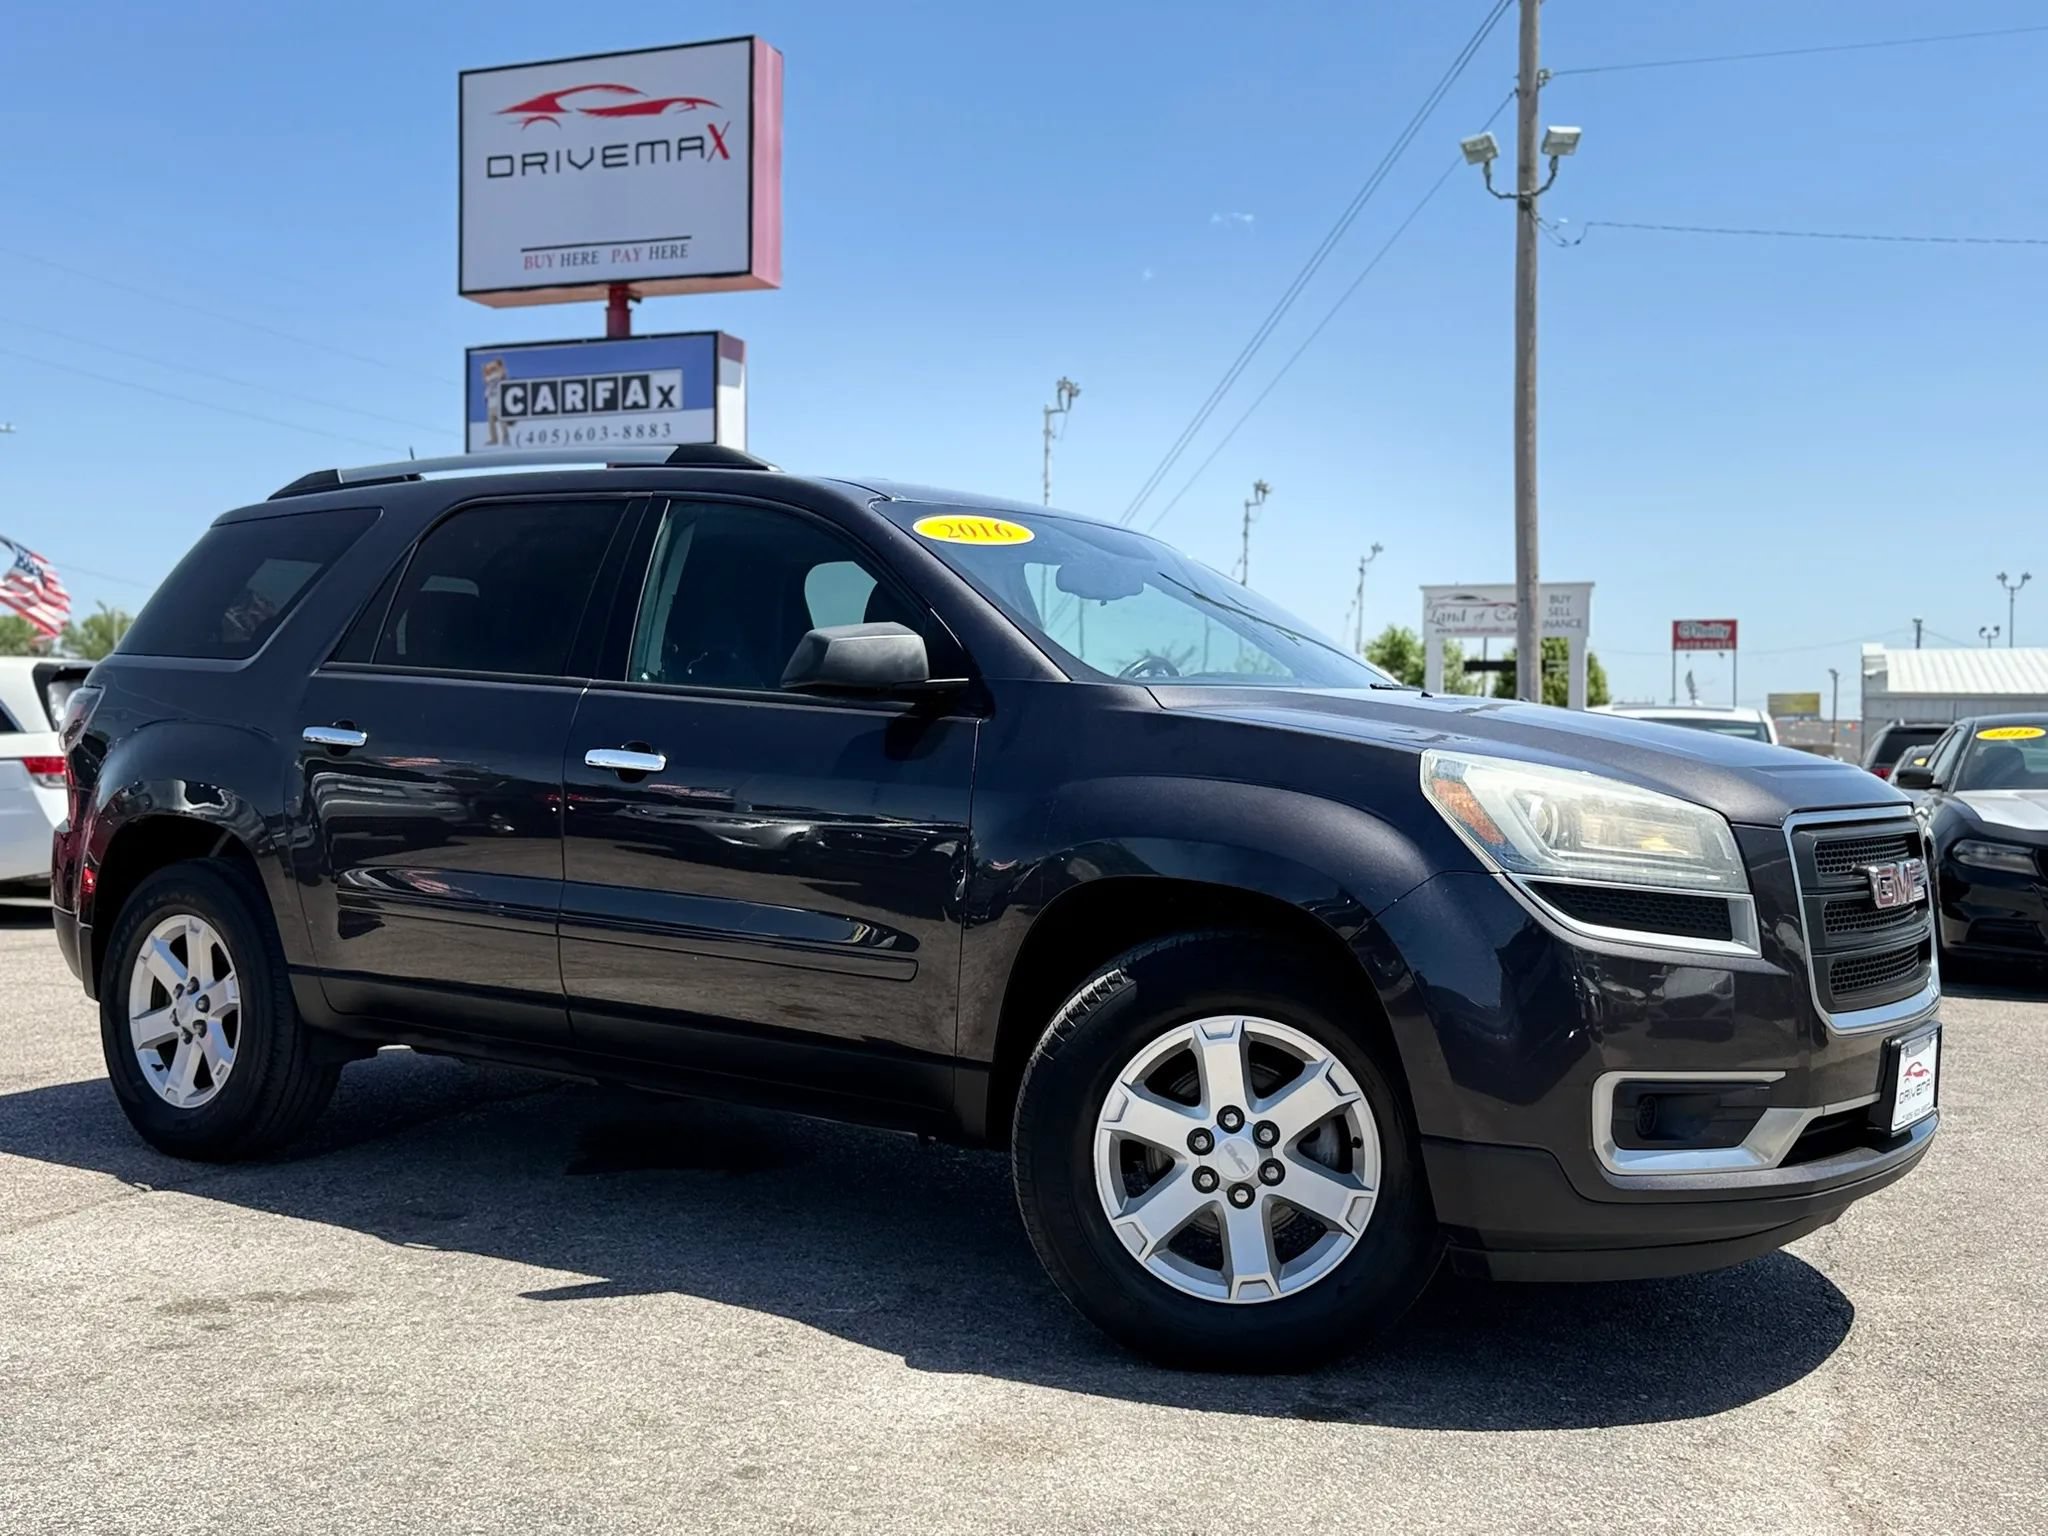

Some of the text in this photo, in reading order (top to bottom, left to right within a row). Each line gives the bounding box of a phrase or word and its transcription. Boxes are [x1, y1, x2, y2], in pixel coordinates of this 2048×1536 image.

[486, 120, 731, 179] DRIVEMAX
[523, 243, 689, 270] BUY HERE PAY HERE
[502, 375, 679, 416] CARFAX
[515, 423, 671, 447] (405)603-8883
[938, 522, 1013, 538] 2016
[1549, 594, 1572, 604] BUY
[1548, 607, 1570, 617] SELL
[1869, 858, 1926, 909] GMC
